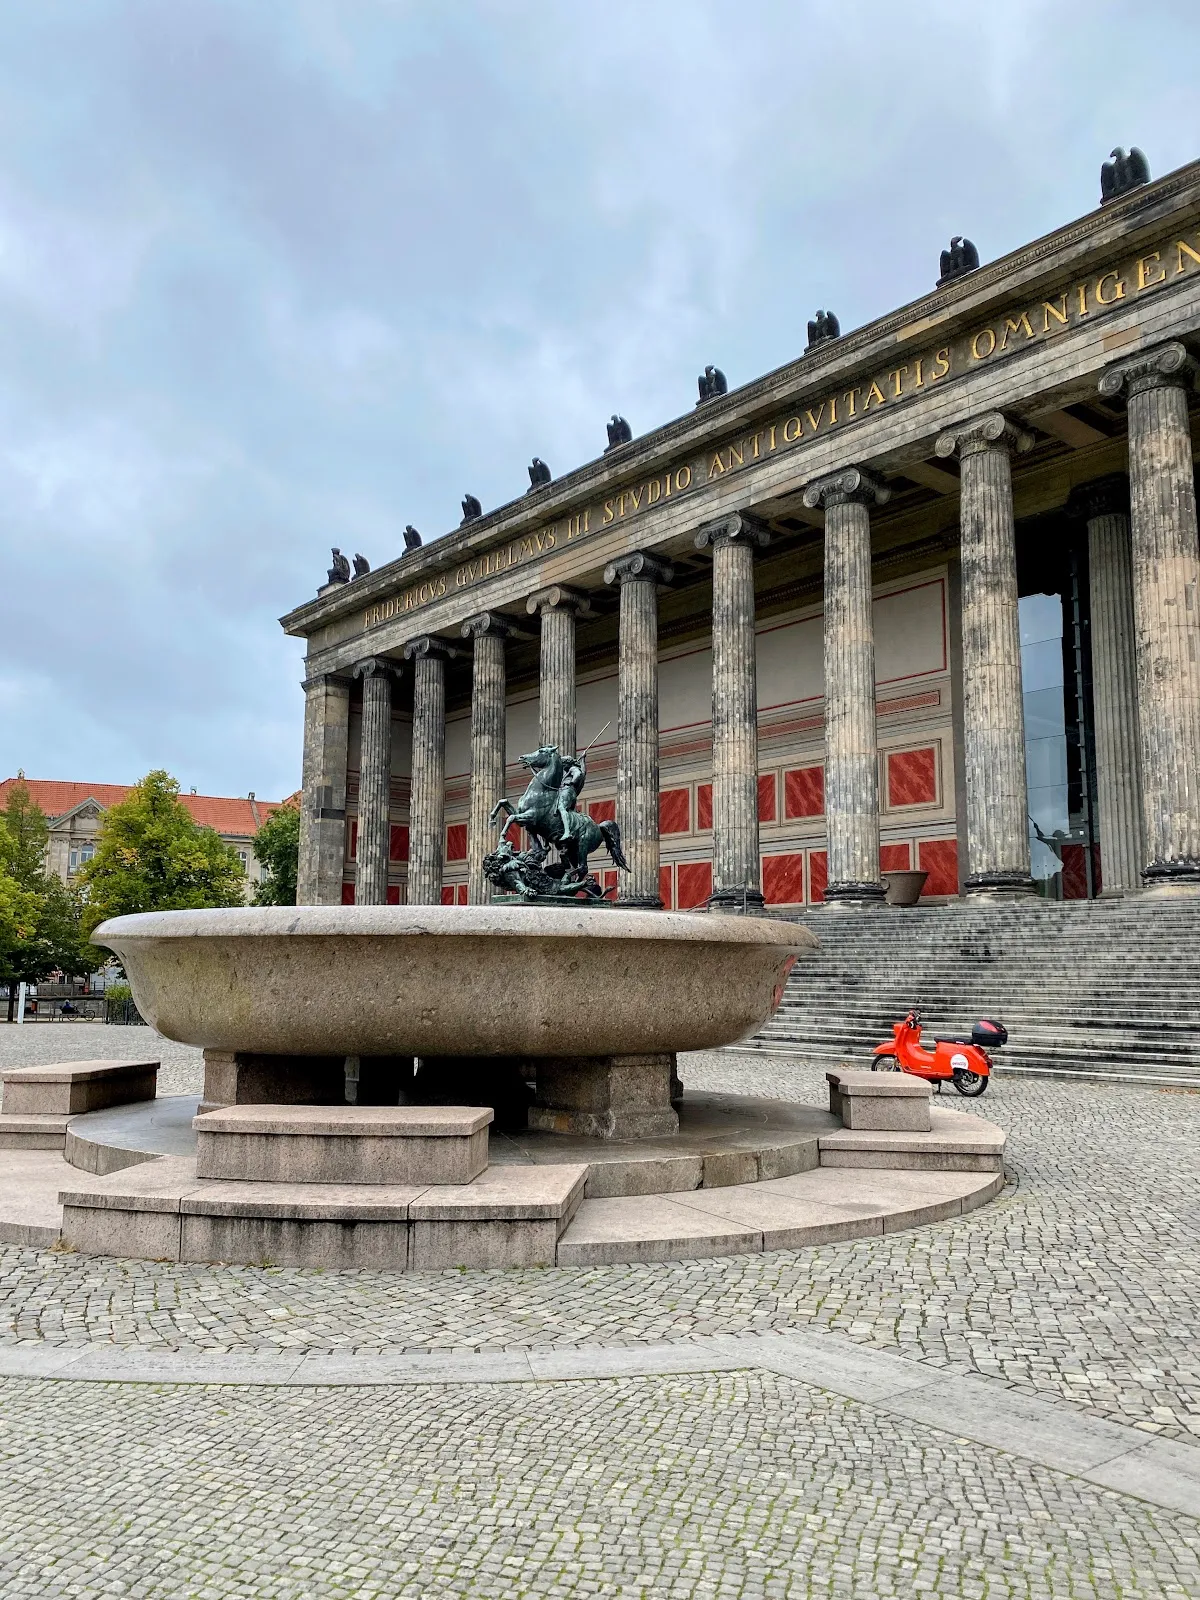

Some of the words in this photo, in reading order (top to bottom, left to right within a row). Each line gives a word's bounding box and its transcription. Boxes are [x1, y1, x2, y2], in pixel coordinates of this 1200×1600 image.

[364, 576, 447, 628] FRIDERICVS
[455, 526, 556, 588] GVILELMVS
[567, 510, 589, 540] III
[602, 466, 692, 525] STVDIO
[708, 347, 951, 479] ANTIQVITATIS
